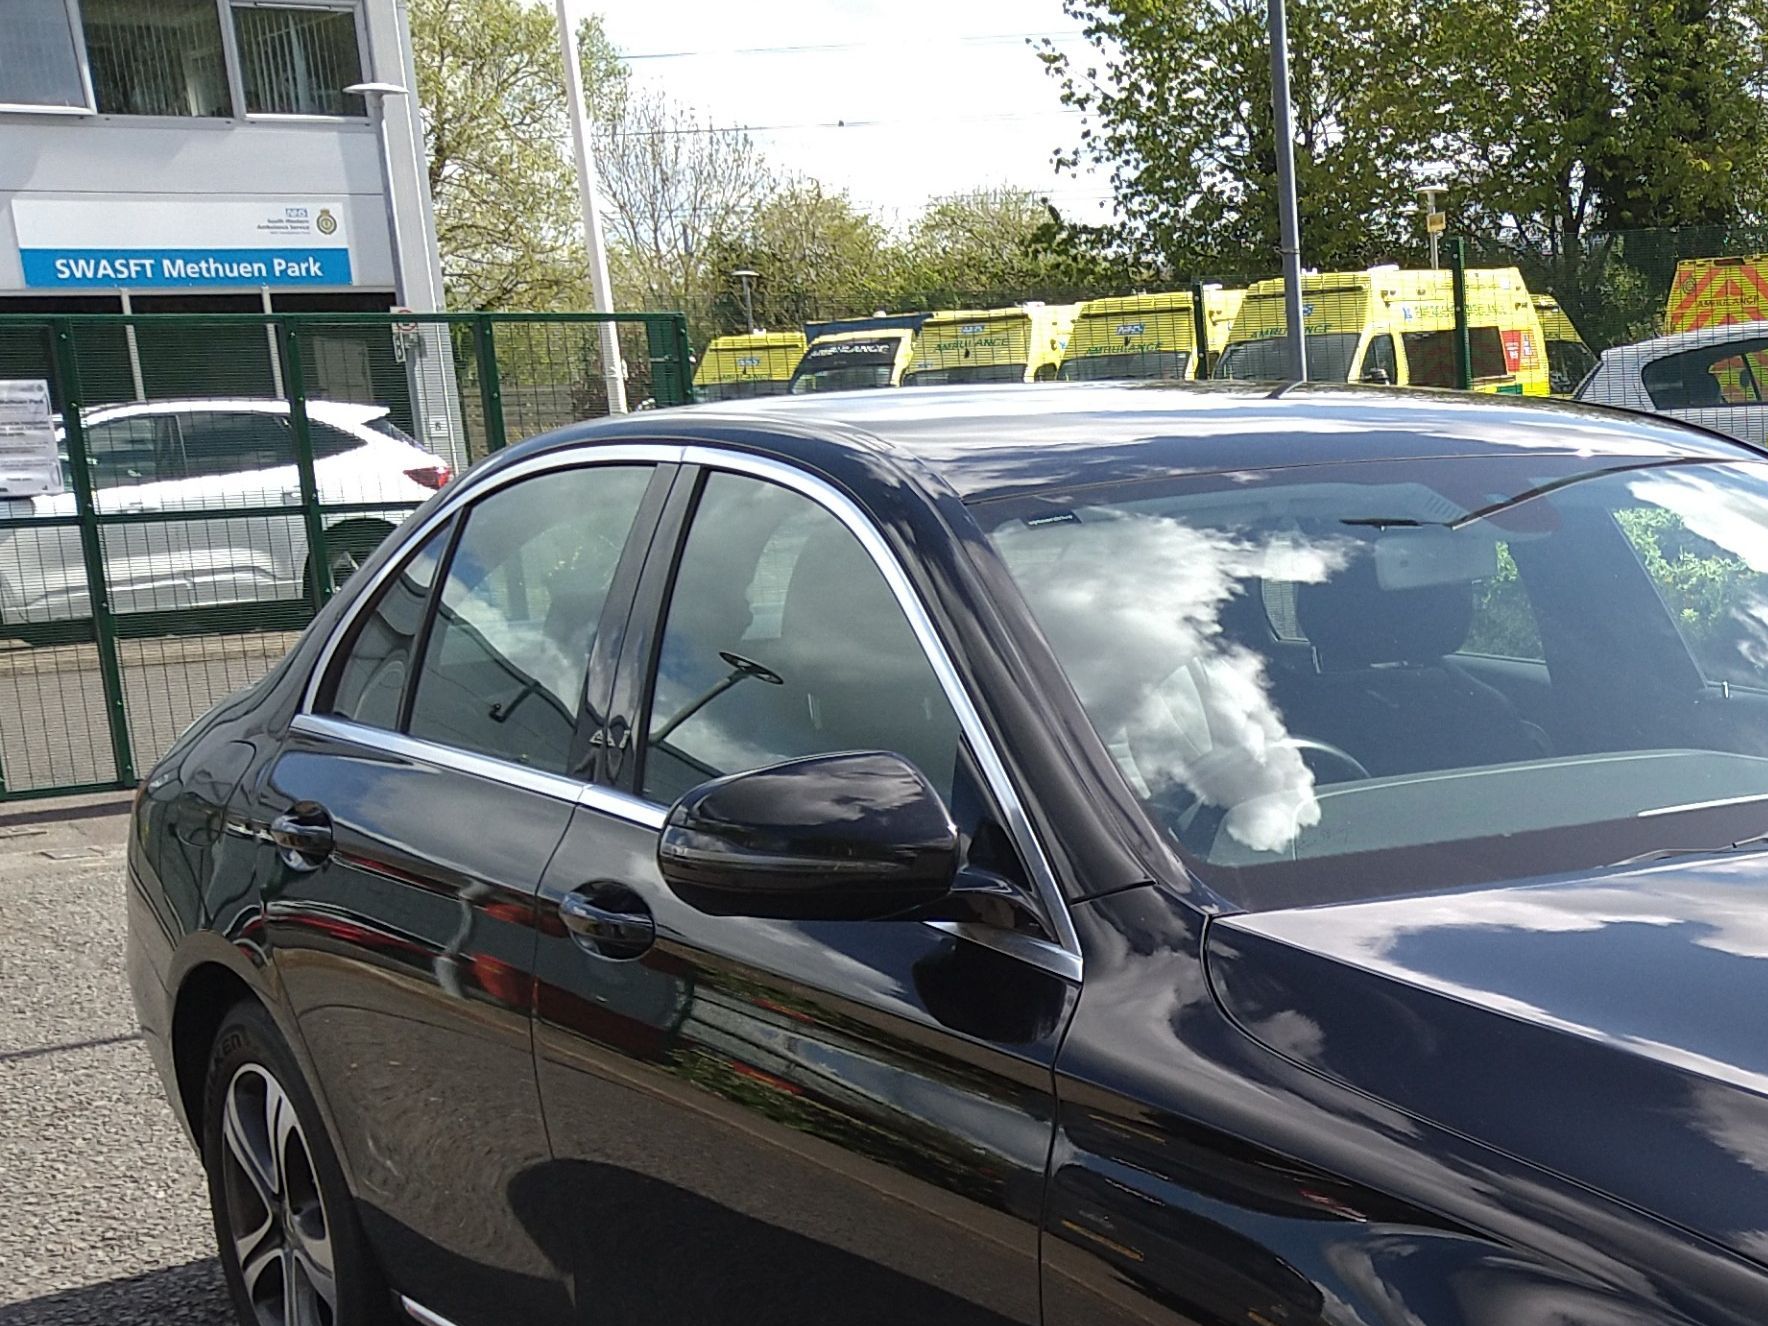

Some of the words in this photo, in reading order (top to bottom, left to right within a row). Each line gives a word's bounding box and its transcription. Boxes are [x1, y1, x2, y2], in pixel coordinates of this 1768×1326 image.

[55, 258, 154, 279] SWASFT
[163, 258, 267, 278] Methuen
[273, 256, 323, 277] Park
[1250, 323, 1332, 339] AMBUNCE
